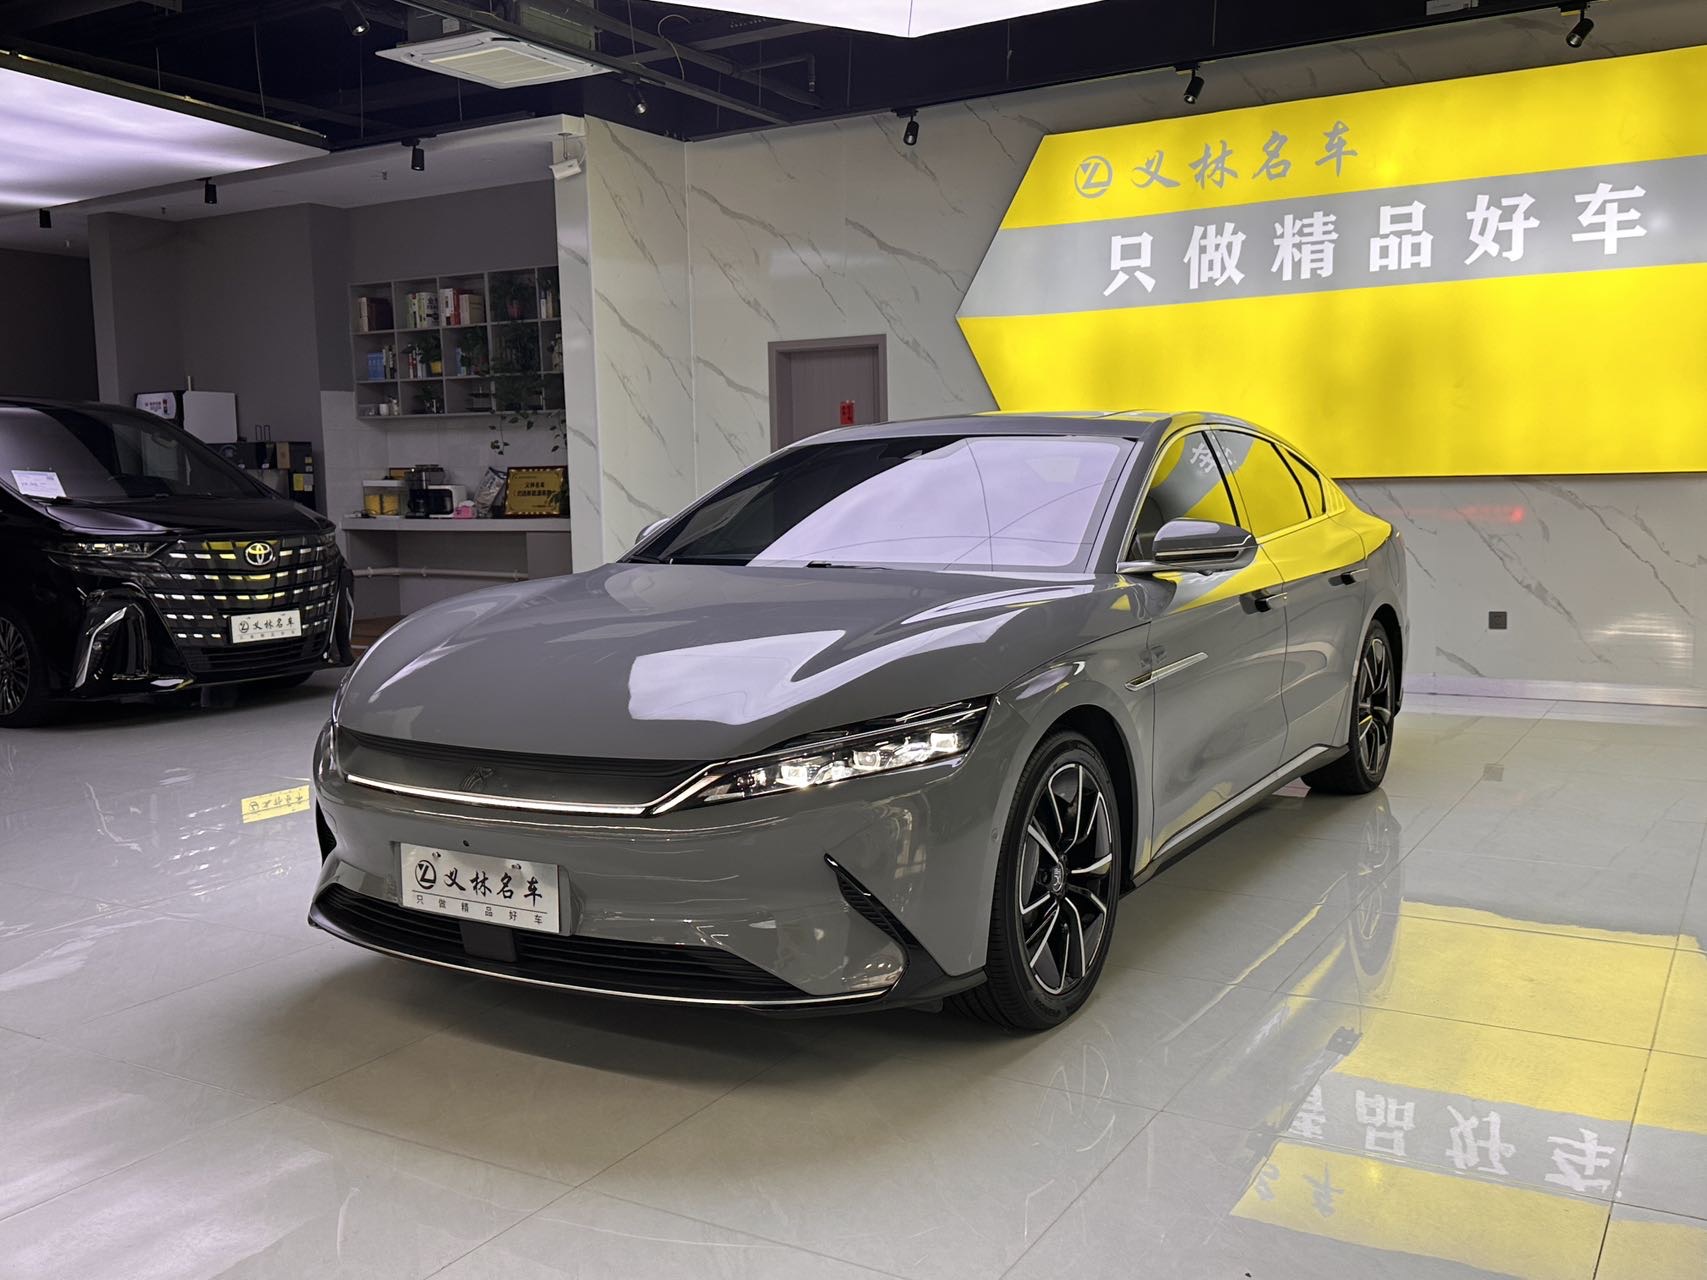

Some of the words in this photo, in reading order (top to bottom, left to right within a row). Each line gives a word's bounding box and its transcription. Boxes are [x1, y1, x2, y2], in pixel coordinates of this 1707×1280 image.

[1131, 120, 1358, 189] 义林名车
[1103, 183, 1647, 296] 只做精品好车
[416, 894, 543, 924] 只做精品好车
[444, 867, 543, 906] 义林名车
